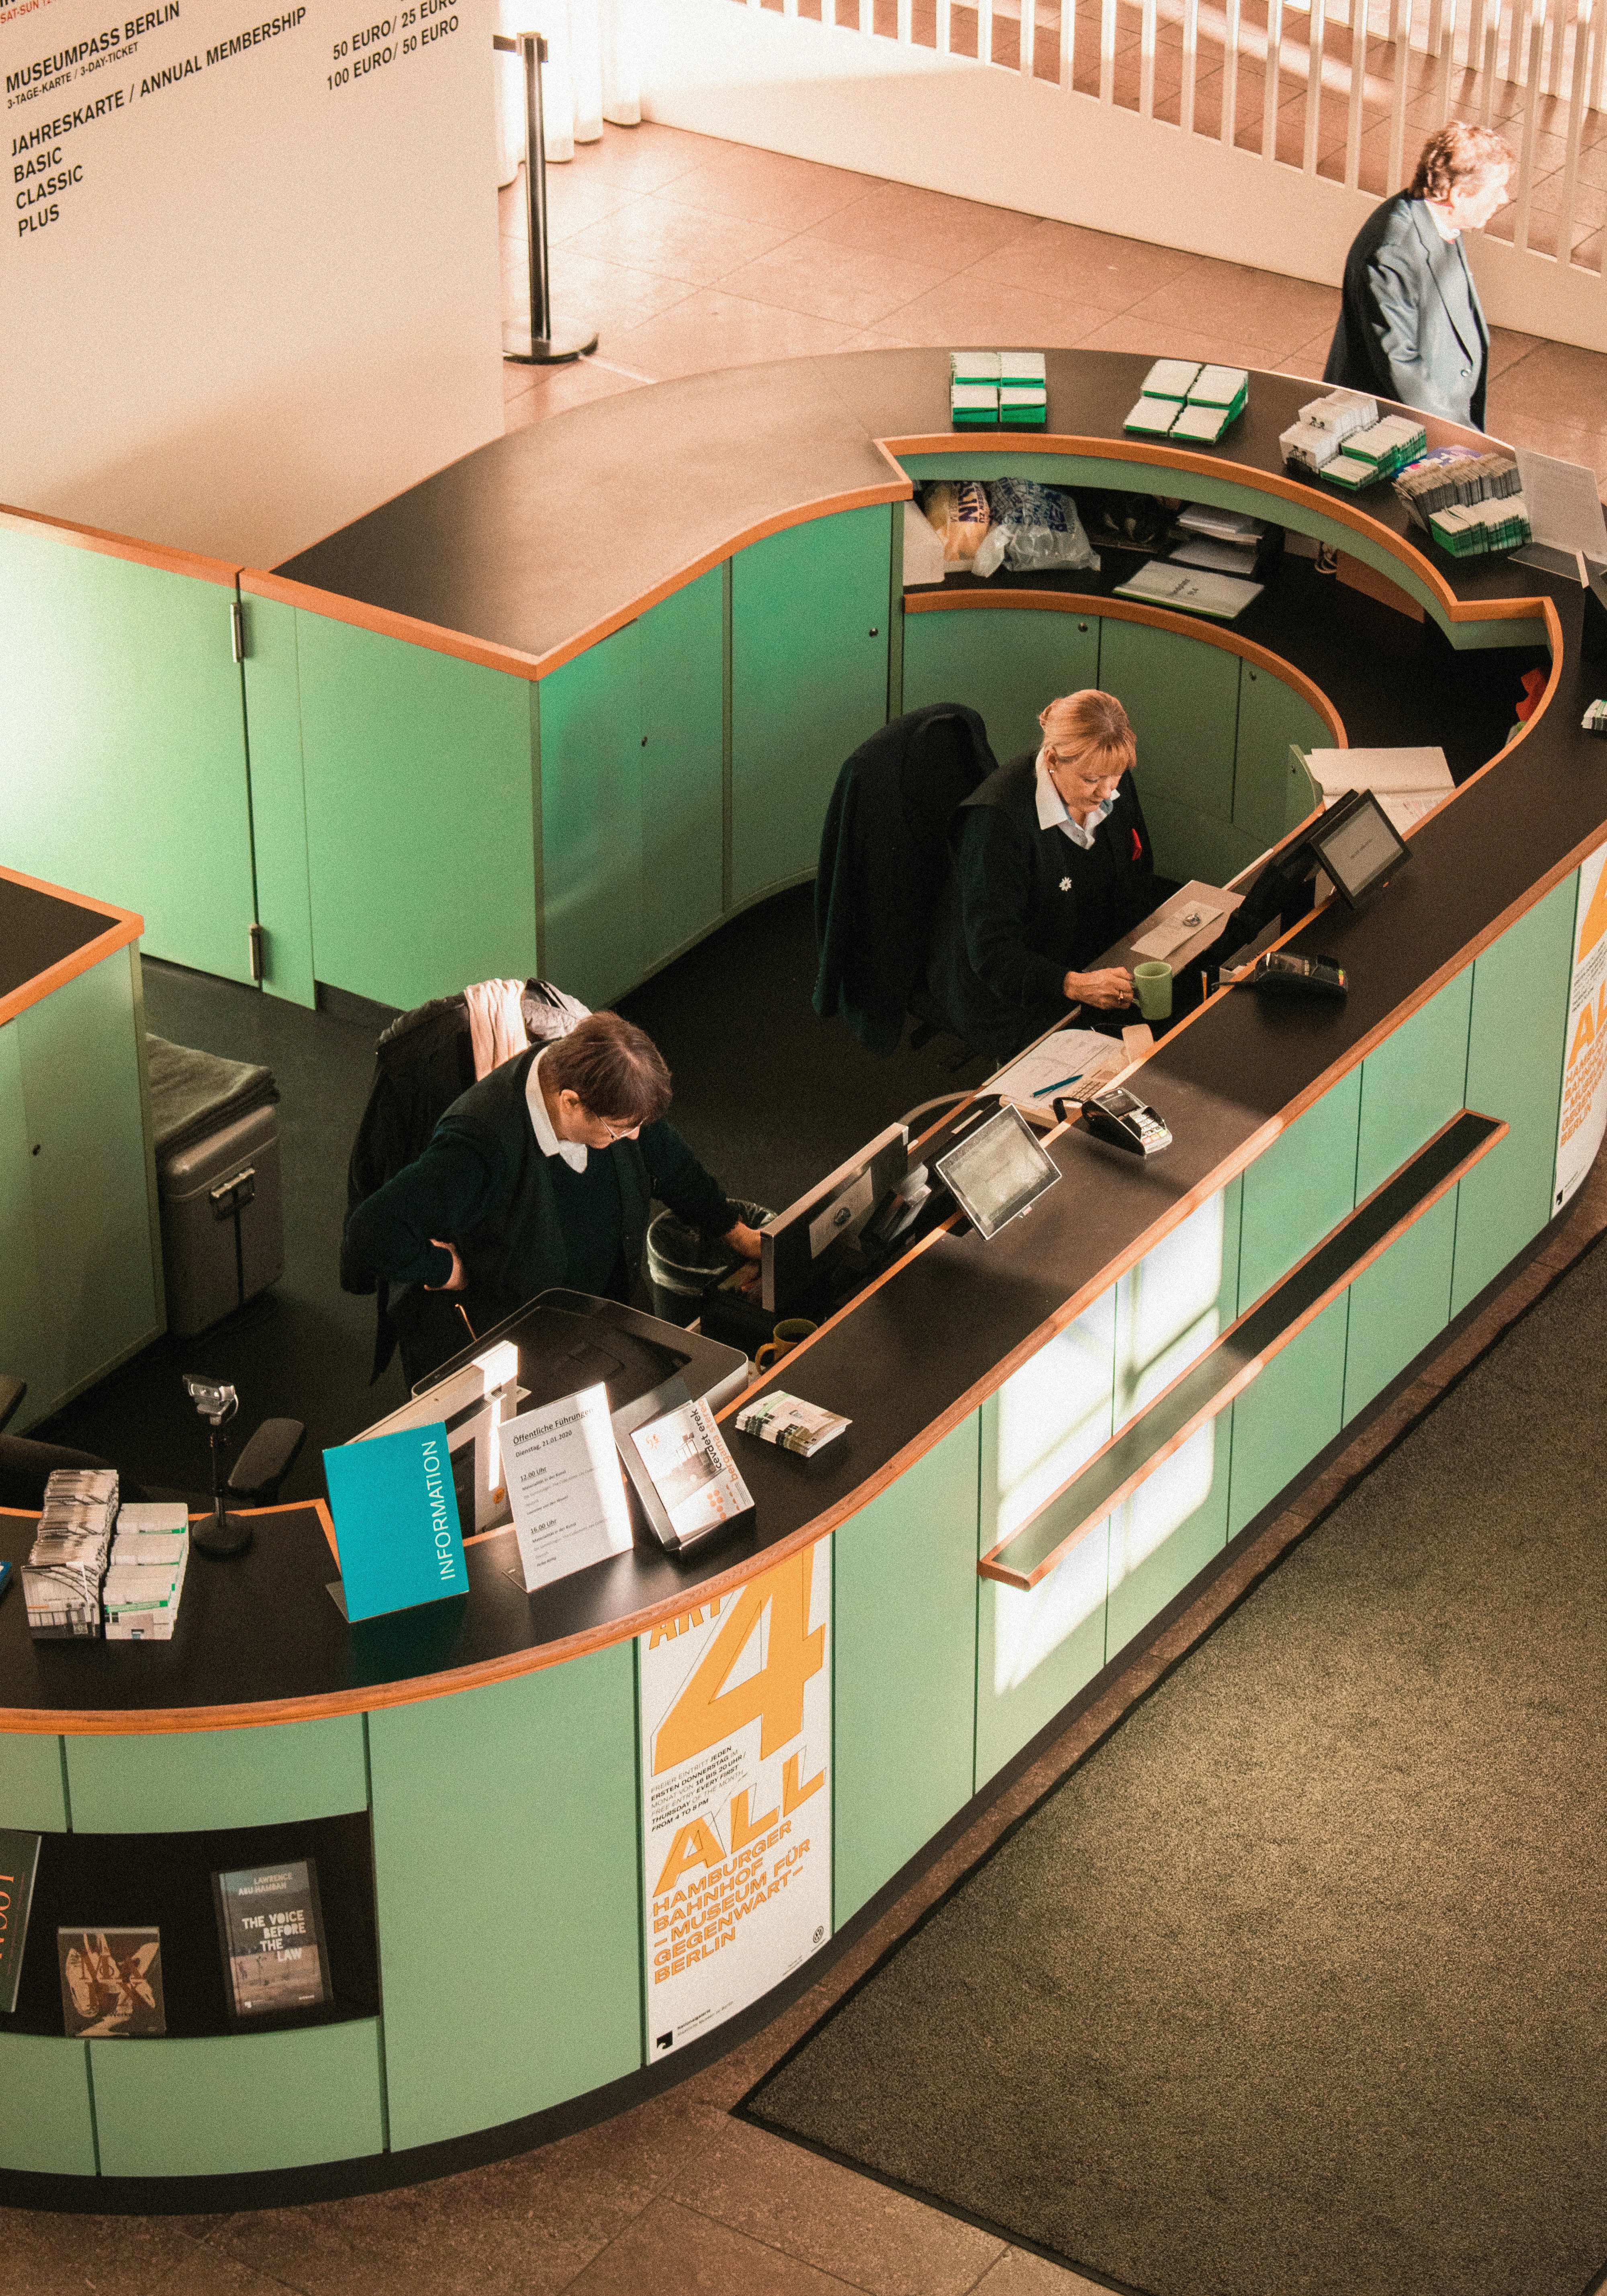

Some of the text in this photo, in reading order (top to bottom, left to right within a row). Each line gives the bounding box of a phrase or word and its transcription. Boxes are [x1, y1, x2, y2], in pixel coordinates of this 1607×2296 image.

[6, 0, 180, 93] MUSEUMPASS BERLIN
[327, 67, 349, 90] 100
[403, 35, 417, 55] 50
[421, 15, 459, 46] EURO
[333, 41, 348, 60] 50
[402, 8, 416, 28] 25
[7, 42, 139, 109] 3-TAGE-KARTE / 3-DAY-TICKET
[11, 6, 307, 157] JAHRESKARTE / ANNUAL MEMBERSHIP
[13, 146, 63, 184] BASIC
[16, 165, 84, 210] CLASSIC
[18, 203, 60, 237] PLUS
[513, 1423, 554, 1445] Öffentliche
[515, 1429, 572, 1458] Dienstag, 21.01.2020
[690, 1408, 722, 1469] cevdet erek
[697, 1399, 739, 1482] bergama stereo
[520, 1471, 536, 1482] 12.00
[421, 1440, 456, 1581] INFORMATION
[531, 1519, 557, 1533] 16.00 Uhr
[651, 1745, 732, 1793] FREIER EINTRITT JEDEN
[651, 1749, 738, 1801] ERSTEN DONNERSTAG IM
[651, 1792, 677, 1808] MONAT
[679, 1783, 694, 1794] VON
[705, 1770, 717, 1780] BIS
[718, 1764, 728, 1773] 20
[728, 1754, 742, 1767] UHR
[651, 1764, 739, 1816] FREE ENTRY EVERY FIRST
[652, 1770, 743, 1824] THURSDAY OF THE MONTH
[652, 1818, 673, 1832] FROM
[682, 1808, 691, 1817] TO
[698, 1798, 709, 1807] PM
[653, 1746, 826, 1897] ALL
[253, 1872, 293, 1886] LAWRENCE
[653, 1820, 792, 1917] HAMBURGER
[671, 1873, 767, 1942] MUSEUM
[774, 1838, 810, 1873] FÜR
[241, 1909, 305, 1929] THE VOICE
[654, 1857, 763, 1934] BAHNHOF
[260, 1938, 284, 1953] THE
[263, 1922, 307, 1939] BEFORE
[277, 1947, 302, 1962] LAW
[654, 1926, 736, 1984] BERLIN
